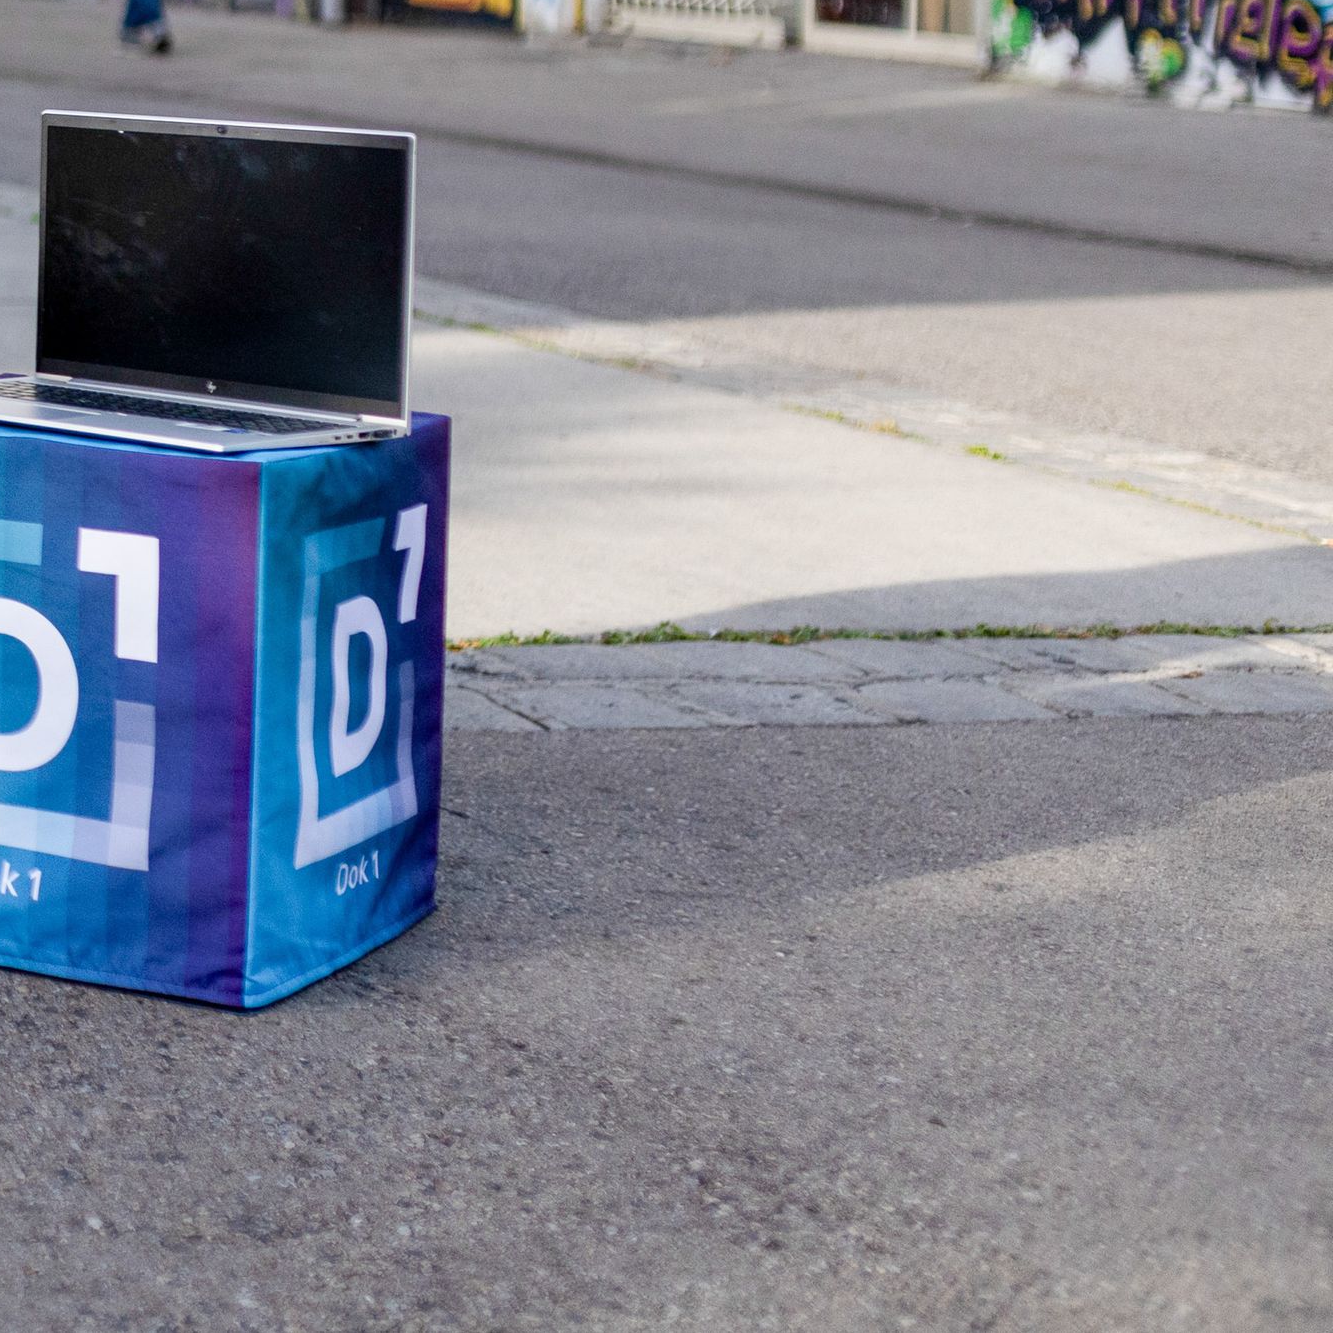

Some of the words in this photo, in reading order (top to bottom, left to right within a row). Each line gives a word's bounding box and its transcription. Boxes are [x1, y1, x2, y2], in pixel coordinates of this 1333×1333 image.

[27, 867, 42, 902] 1
[335, 854, 369, 897] Dok
[372, 850, 380, 879] 1
